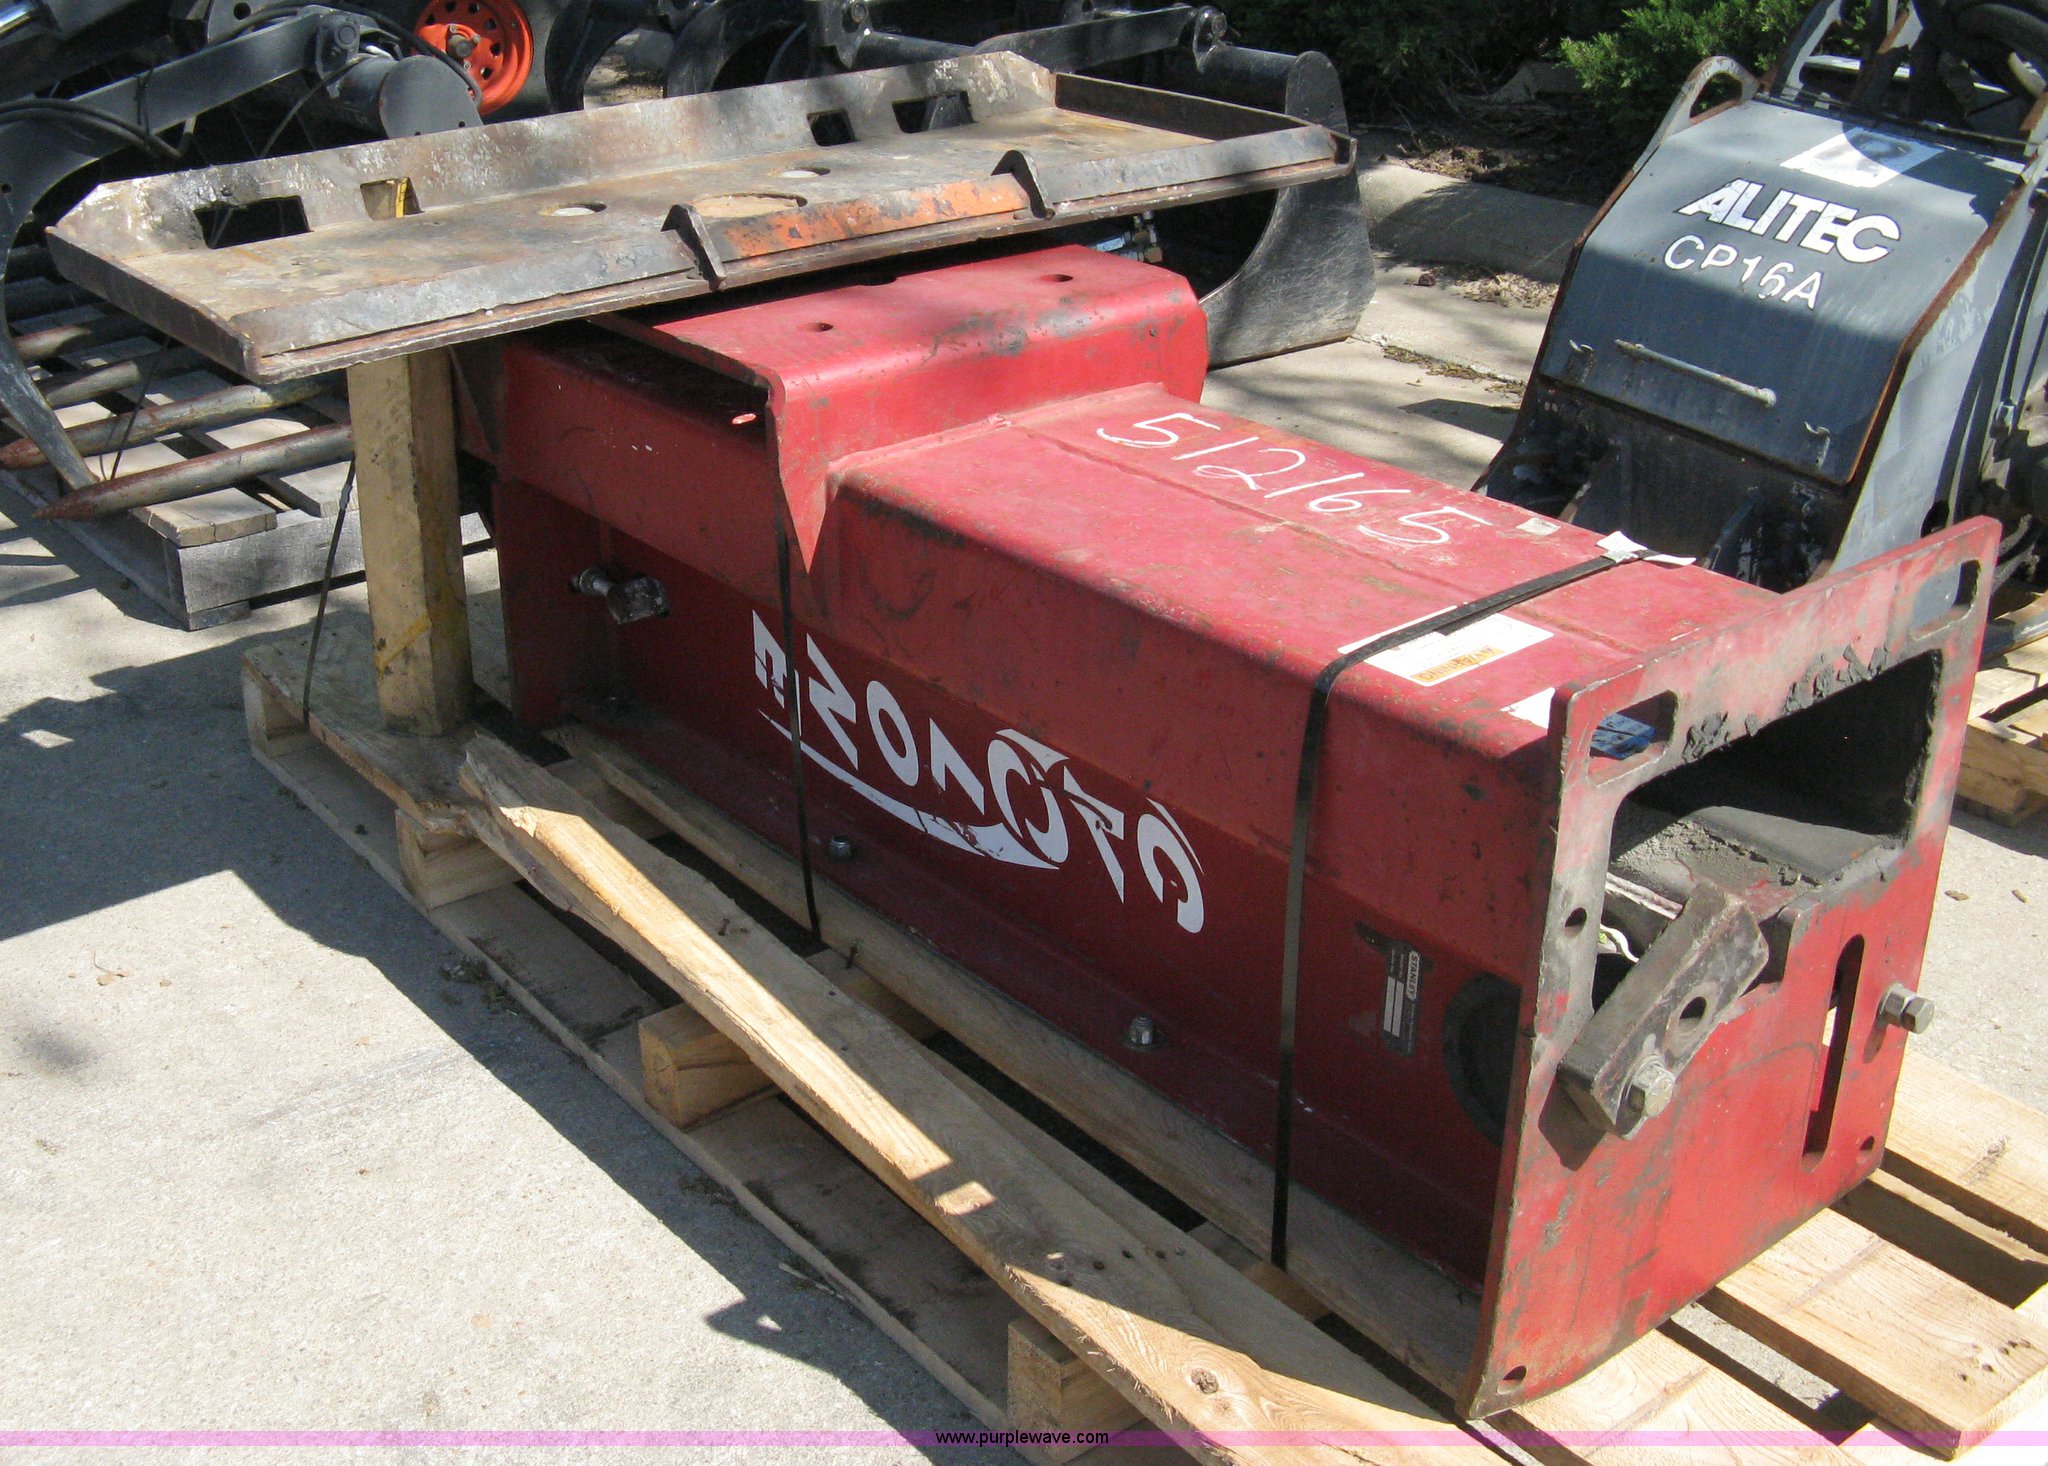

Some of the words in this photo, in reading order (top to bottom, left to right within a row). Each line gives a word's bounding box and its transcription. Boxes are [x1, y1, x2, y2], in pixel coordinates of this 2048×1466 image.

[1675, 178, 1902, 264] ALITEC
[1663, 235, 1824, 310] CP16A
[1095, 412, 1494, 546] 512165
[1406, 954, 1420, 998] STANLEY
